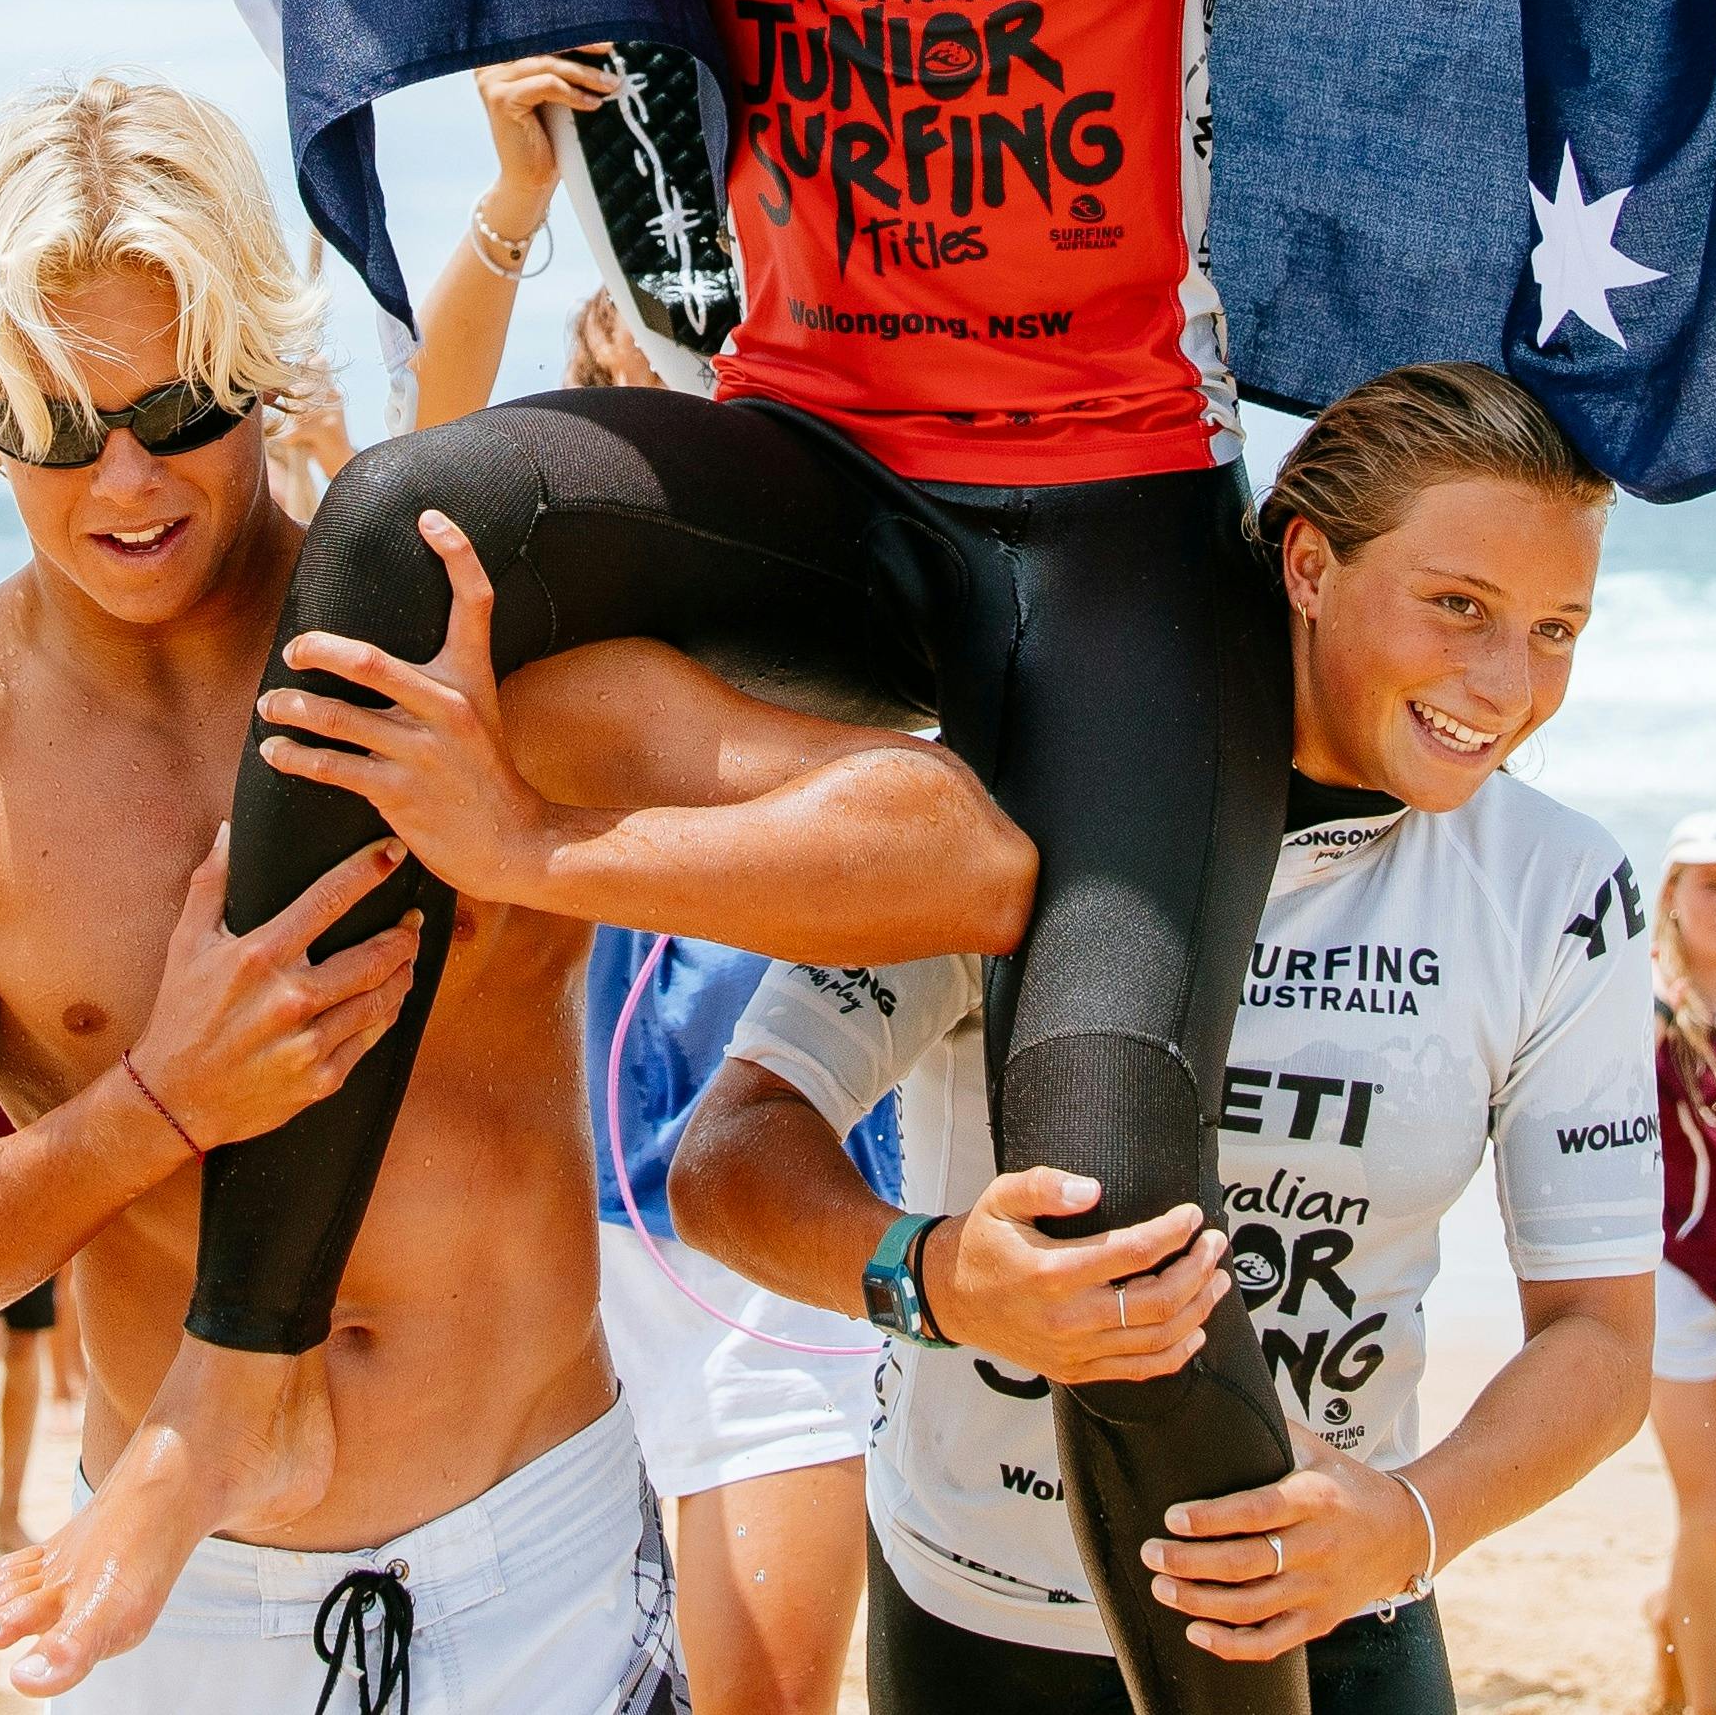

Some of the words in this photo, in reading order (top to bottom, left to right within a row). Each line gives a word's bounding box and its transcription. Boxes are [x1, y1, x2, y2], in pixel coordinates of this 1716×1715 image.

[748, 90, 1125, 283] SURFING
[861, 214, 989, 276] Titles
[1049, 226, 1124, 242] SURFING
[787, 296, 979, 340] Wollongong,
[988, 310, 1073, 340] NSW
[1556, 1112, 1662, 1155] WOLLON
